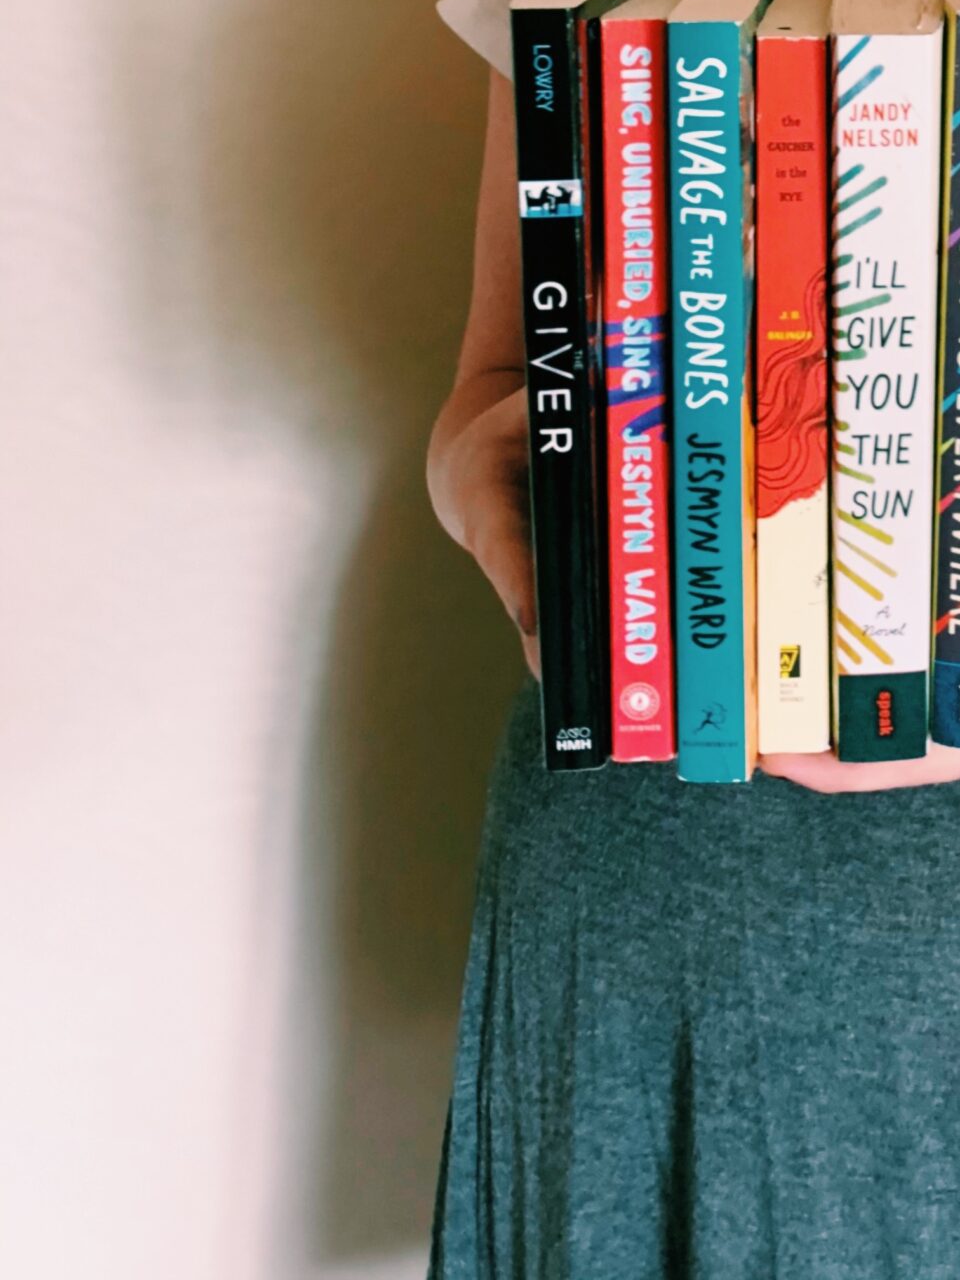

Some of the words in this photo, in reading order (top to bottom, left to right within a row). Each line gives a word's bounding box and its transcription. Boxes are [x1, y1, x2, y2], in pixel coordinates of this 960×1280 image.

[533, 44, 554, 112] LOWRY
[619, 44, 652, 135] SING,
[781, 115, 800, 127] the
[849, 103, 912, 122] JANDY
[675, 57, 727, 225] SALVAGE
[767, 142, 815, 152] CATCHER
[842, 128, 919, 147] NELSON
[789, 166, 807, 178] the
[780, 192, 802, 202] RYE
[619, 141, 652, 308] UNBURIED,
[690, 234, 714, 280] THE
[855, 257, 906, 290] I'LL
[621, 316, 652, 392] SING
[679, 290, 729, 410] BONES
[846, 316, 916, 350] GIVE
[530, 280, 575, 454] GIVER
[847, 373, 918, 410] YOU
[852, 433, 912, 466] THE
[621, 428, 653, 553] JESMYN
[686, 433, 726, 554] JESMYN
[851, 489, 913, 520] SUN
[623, 568, 658, 665] WARD
[687, 565, 728, 649] WARD
[877, 691, 894, 736] speak
[556, 739, 592, 751] HMH
